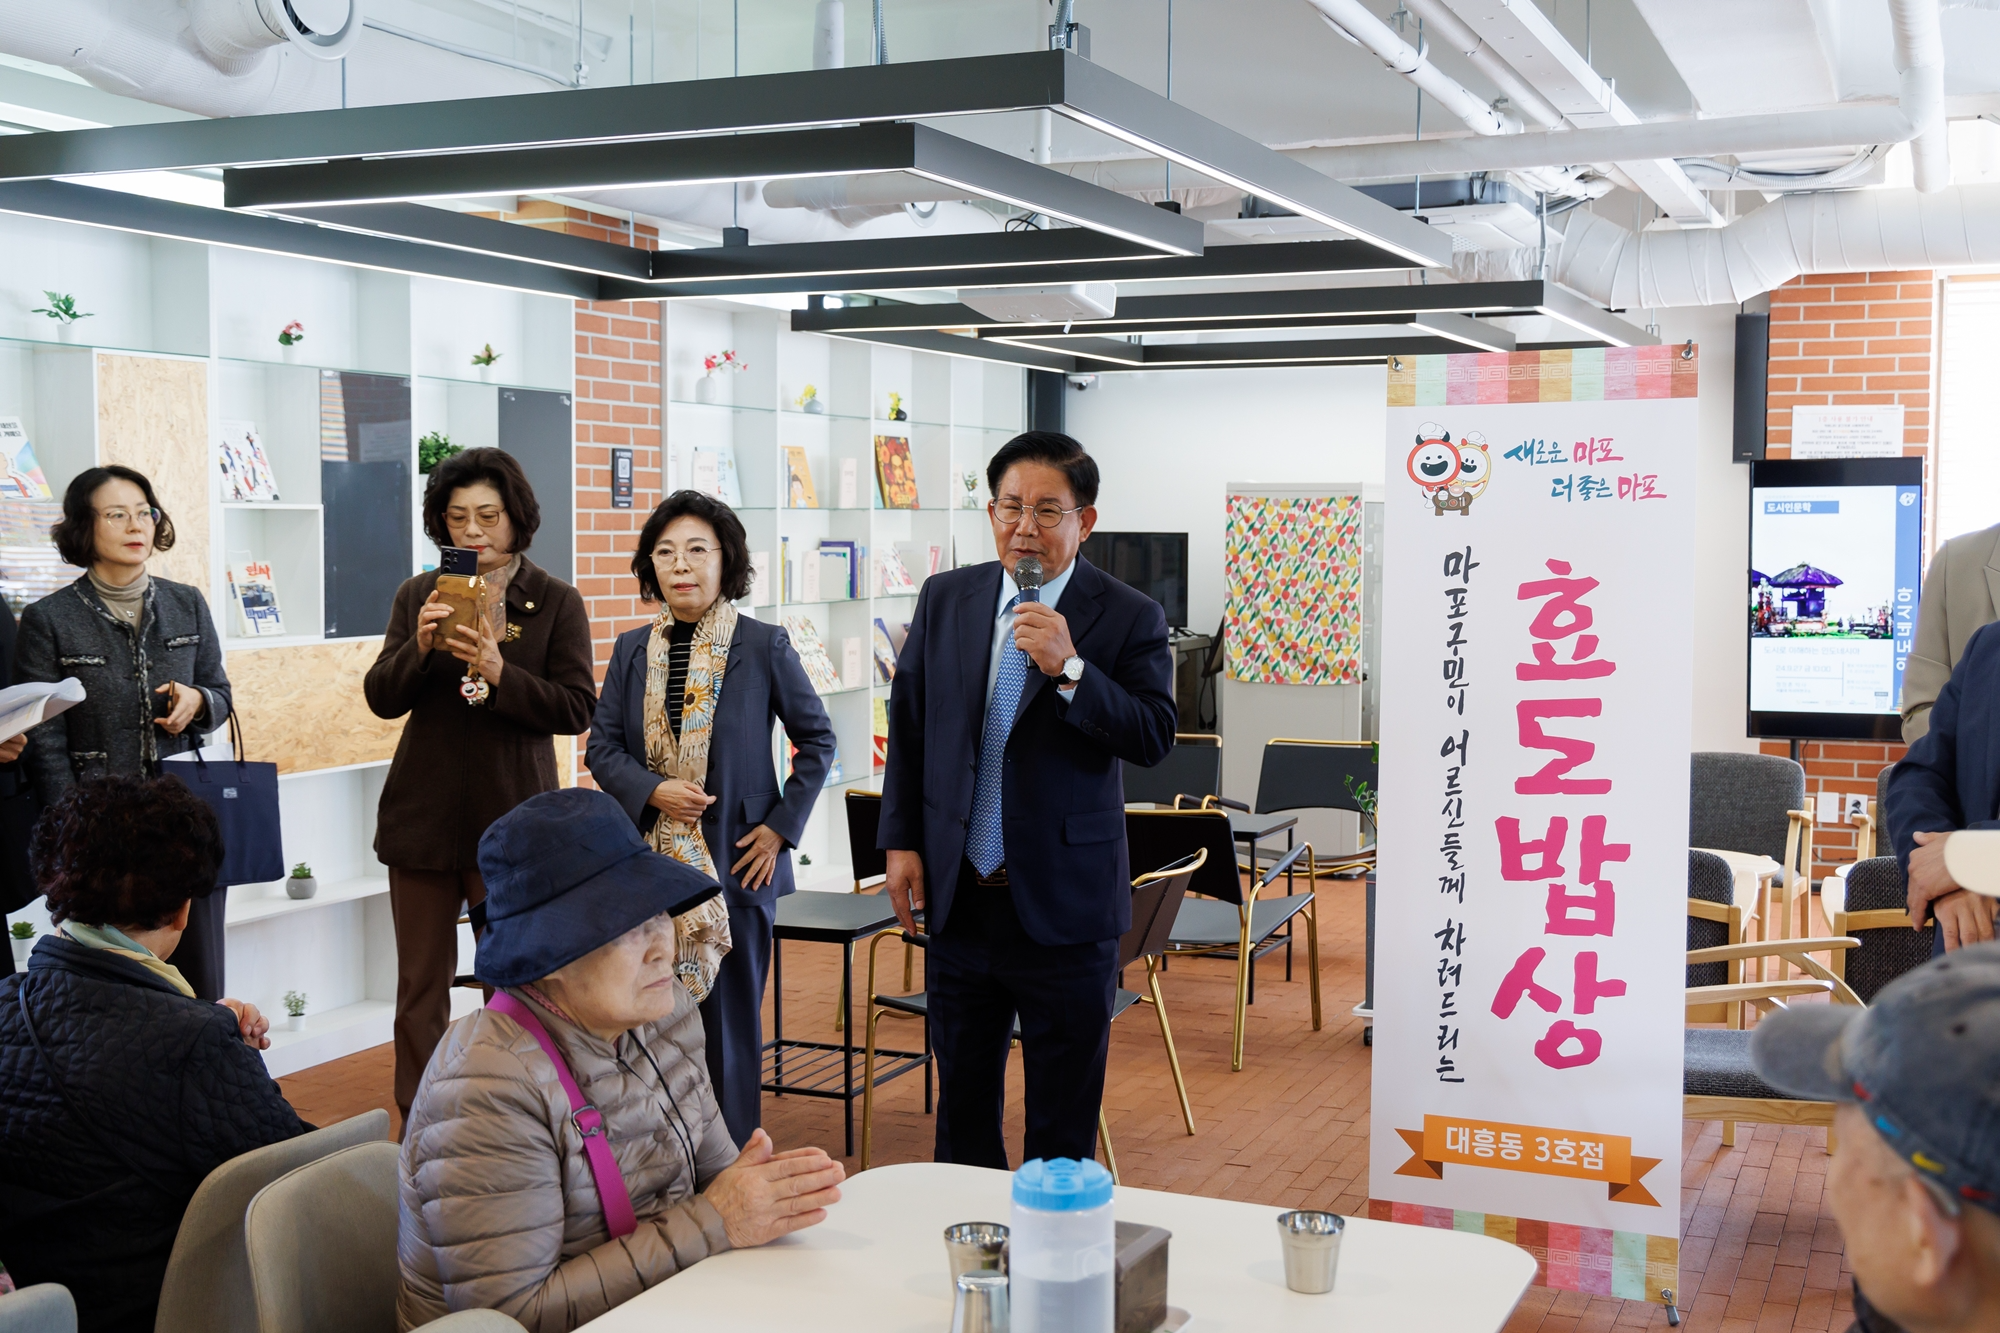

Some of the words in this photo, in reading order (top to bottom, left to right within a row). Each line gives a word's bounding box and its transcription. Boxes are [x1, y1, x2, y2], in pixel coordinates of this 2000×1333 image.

[1503, 438, 1568, 466] 새로운
[1573, 437, 1624, 465] 마포
[1552, 474, 1573, 502] 더
[1577, 474, 1613, 502] 좋은
[1618, 473, 1667, 502] 마포
[1766, 502, 1812, 513] 도시인문학
[1443, 546, 1480, 716] 마포구민이
[1821, 646, 1860, 655] 인도네시아
[1439, 729, 1470, 904] 어르신들께
[1490, 558, 1631, 1070] 효도밥상
[1434, 917, 1467, 1083] 차려드리는
[1445, 1125, 1524, 1161] 대흥동
[1534, 1136, 1604, 1171] 3호점
